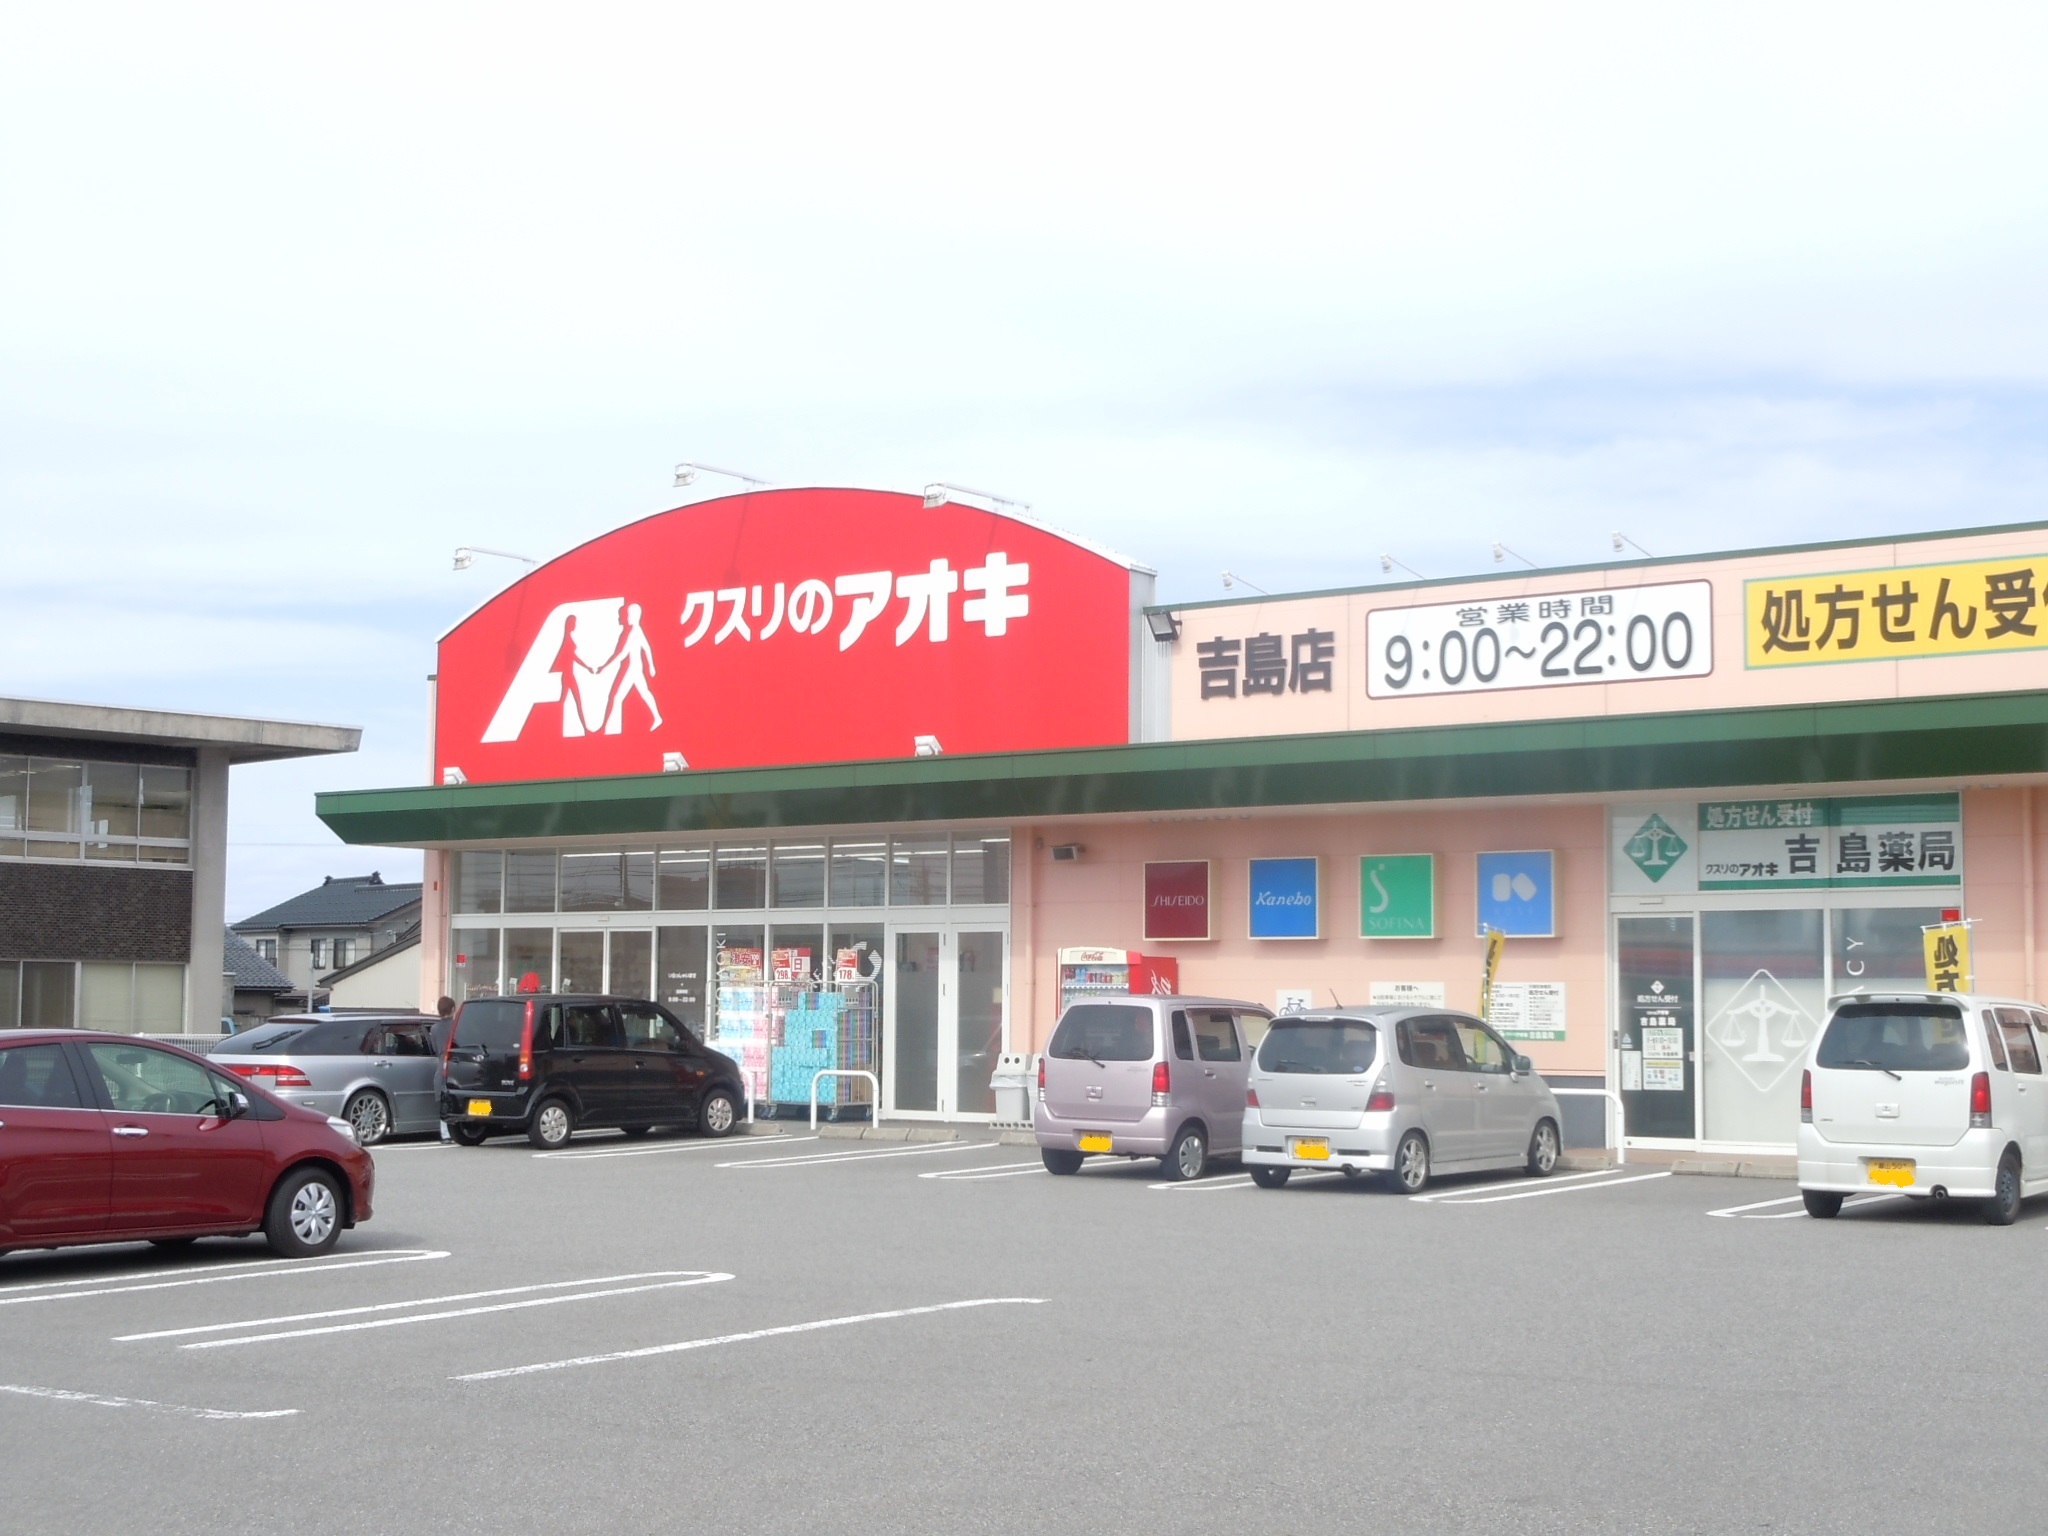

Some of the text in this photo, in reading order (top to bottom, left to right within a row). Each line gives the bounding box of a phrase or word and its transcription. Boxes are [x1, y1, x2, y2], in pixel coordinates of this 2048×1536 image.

[681, 551, 1030, 652] クスリのアオキ
[1456, 594, 1615, 627] 営業時間
[1761, 567, 2048, 655] 処方せん受
[1197, 627, 1336, 700] 吉島店
[1707, 802, 1814, 828] 処方せん受付
[1705, 861, 1779, 877] クスリのアオキ
[1150, 894, 1205, 907] SHISEIDO
[1255, 890, 1313, 906] Kanebo
[1368, 916, 1425, 931] SOFINA
